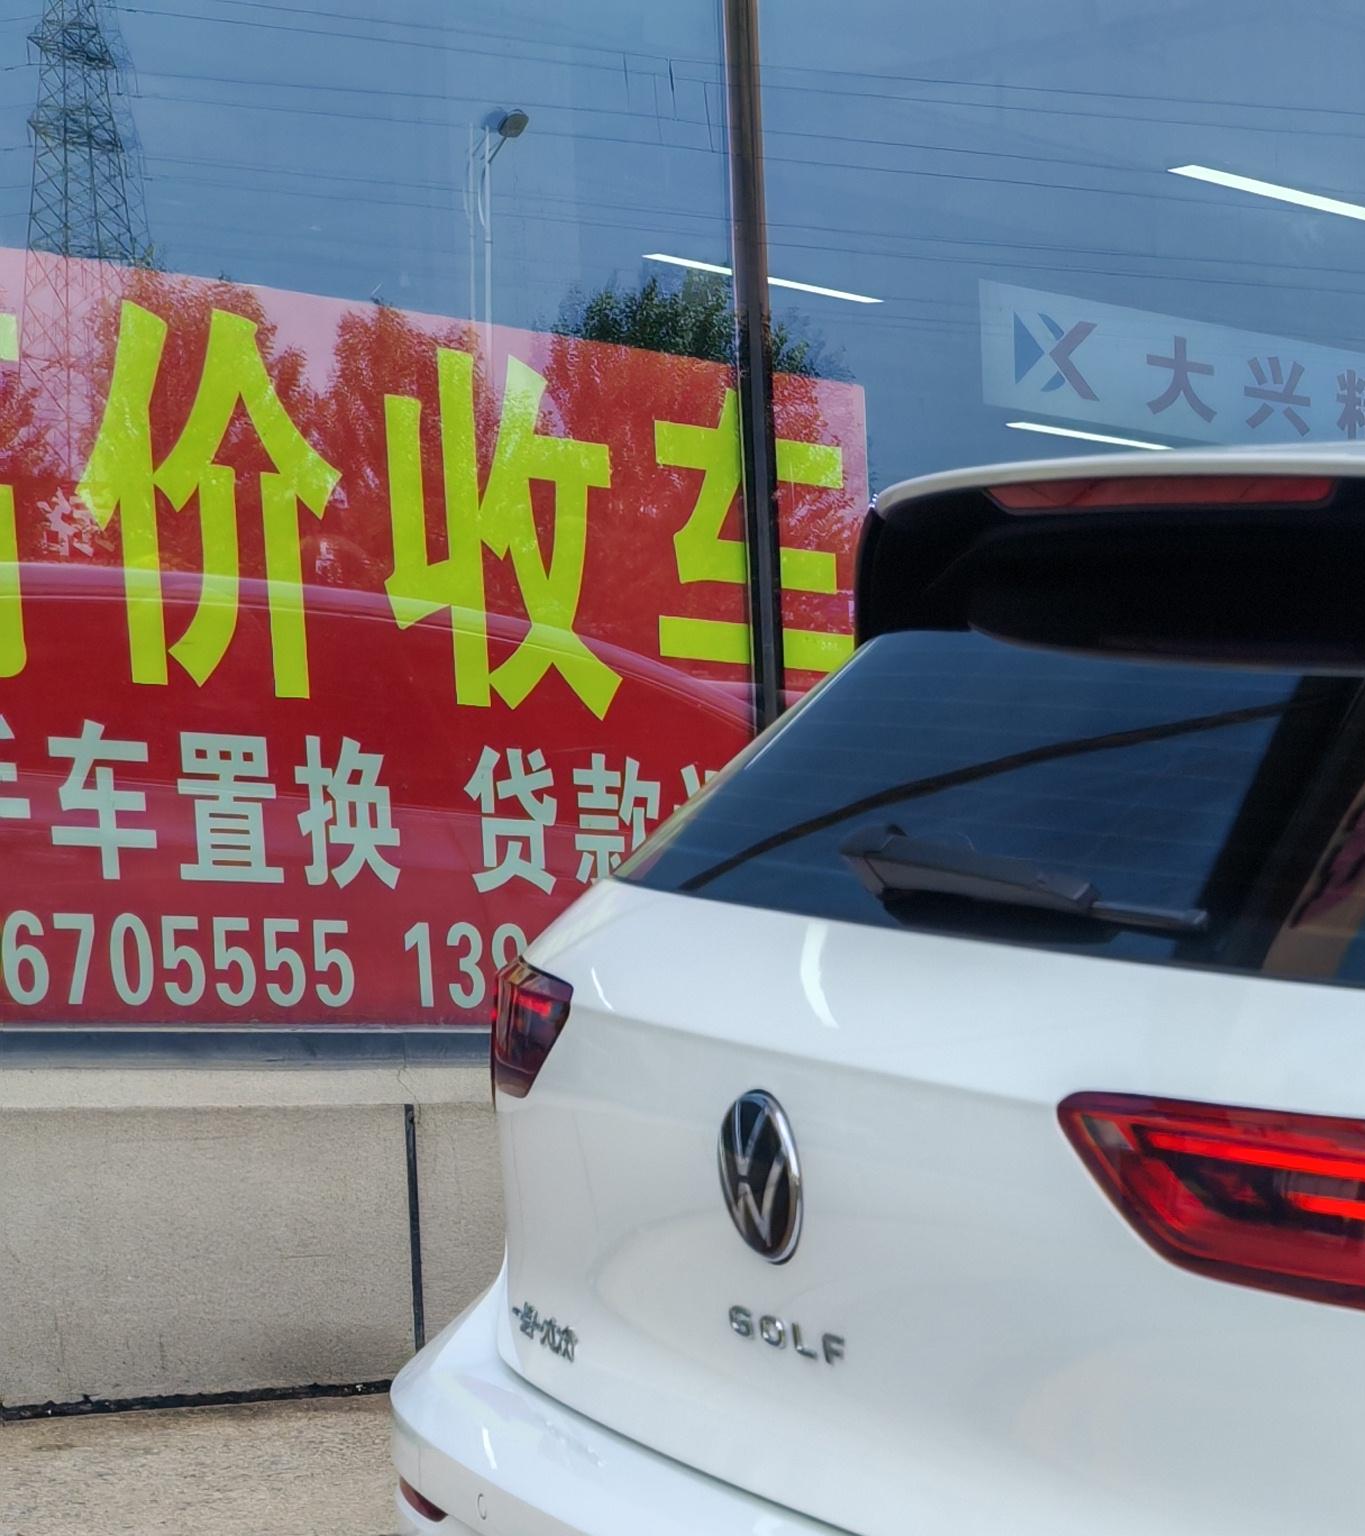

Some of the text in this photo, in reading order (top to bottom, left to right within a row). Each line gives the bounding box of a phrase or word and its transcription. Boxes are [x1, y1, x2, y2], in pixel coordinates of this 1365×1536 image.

[0, 299, 857, 721] 价收车
[463, 745, 721, 895] 贷款
[0, 909, 356, 1008] 6705555
[728, 1304, 846, 1366] GOLF
